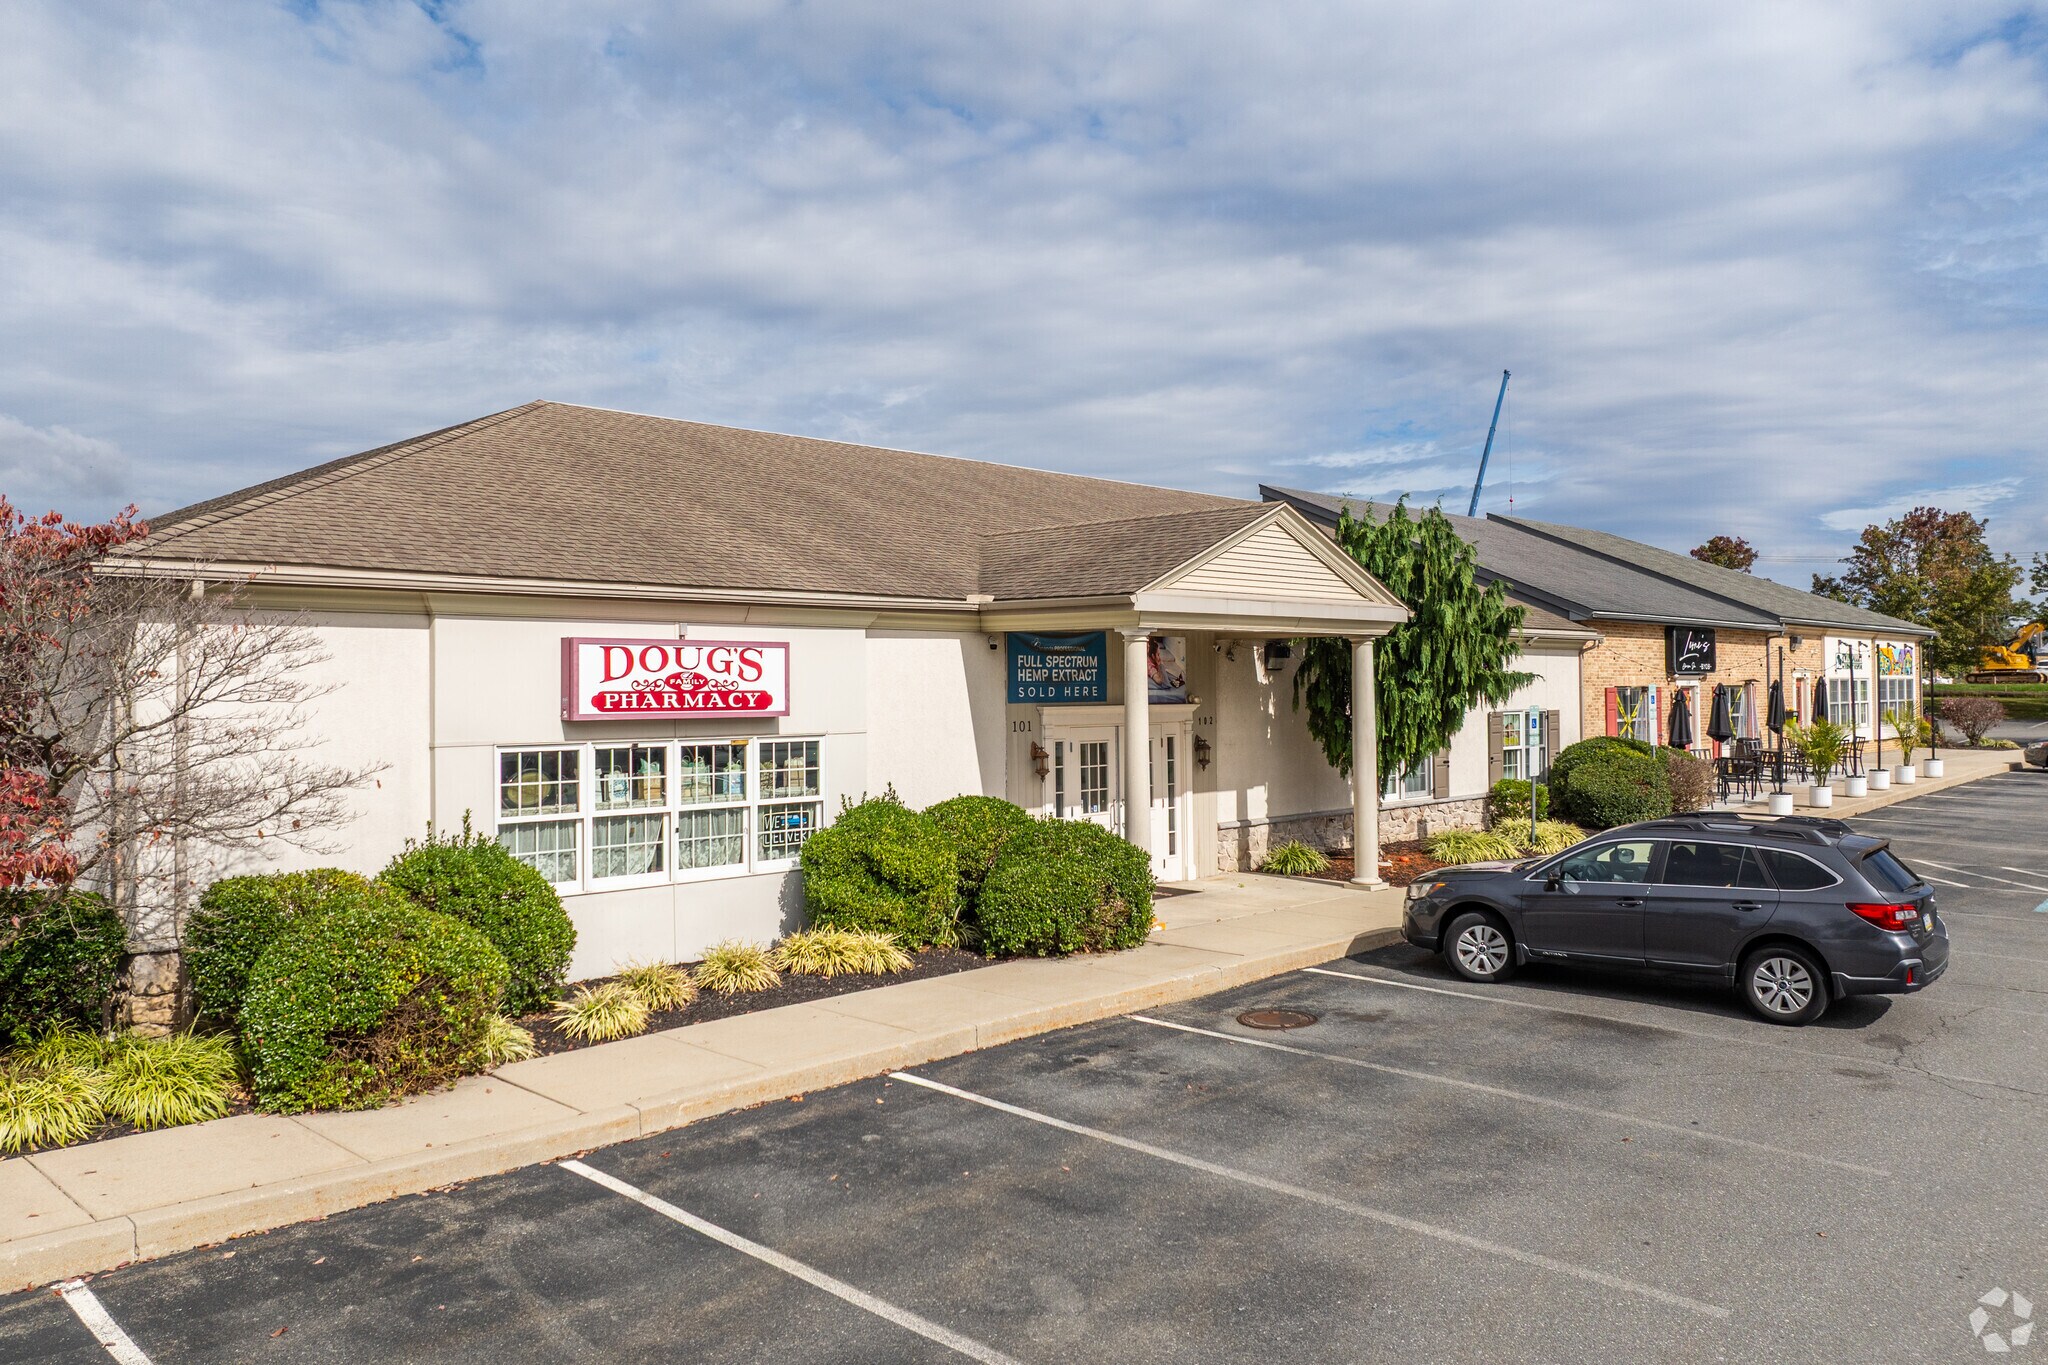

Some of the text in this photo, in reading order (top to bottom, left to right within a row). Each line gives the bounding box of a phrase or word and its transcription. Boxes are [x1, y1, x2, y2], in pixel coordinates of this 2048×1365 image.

[600, 645, 763, 684] DOUG'S
[1017, 655, 1098, 668] FULL SPECTRUM
[1017, 668, 1098, 682] HEMP EXTRACT
[1018, 686, 1098, 698] SOLD HERE
[603, 692, 761, 709] PHARMACY
[1012, 720, 1032, 733] 101
[1198, 716, 1213, 725] 102
[764, 815, 780, 830] WE
